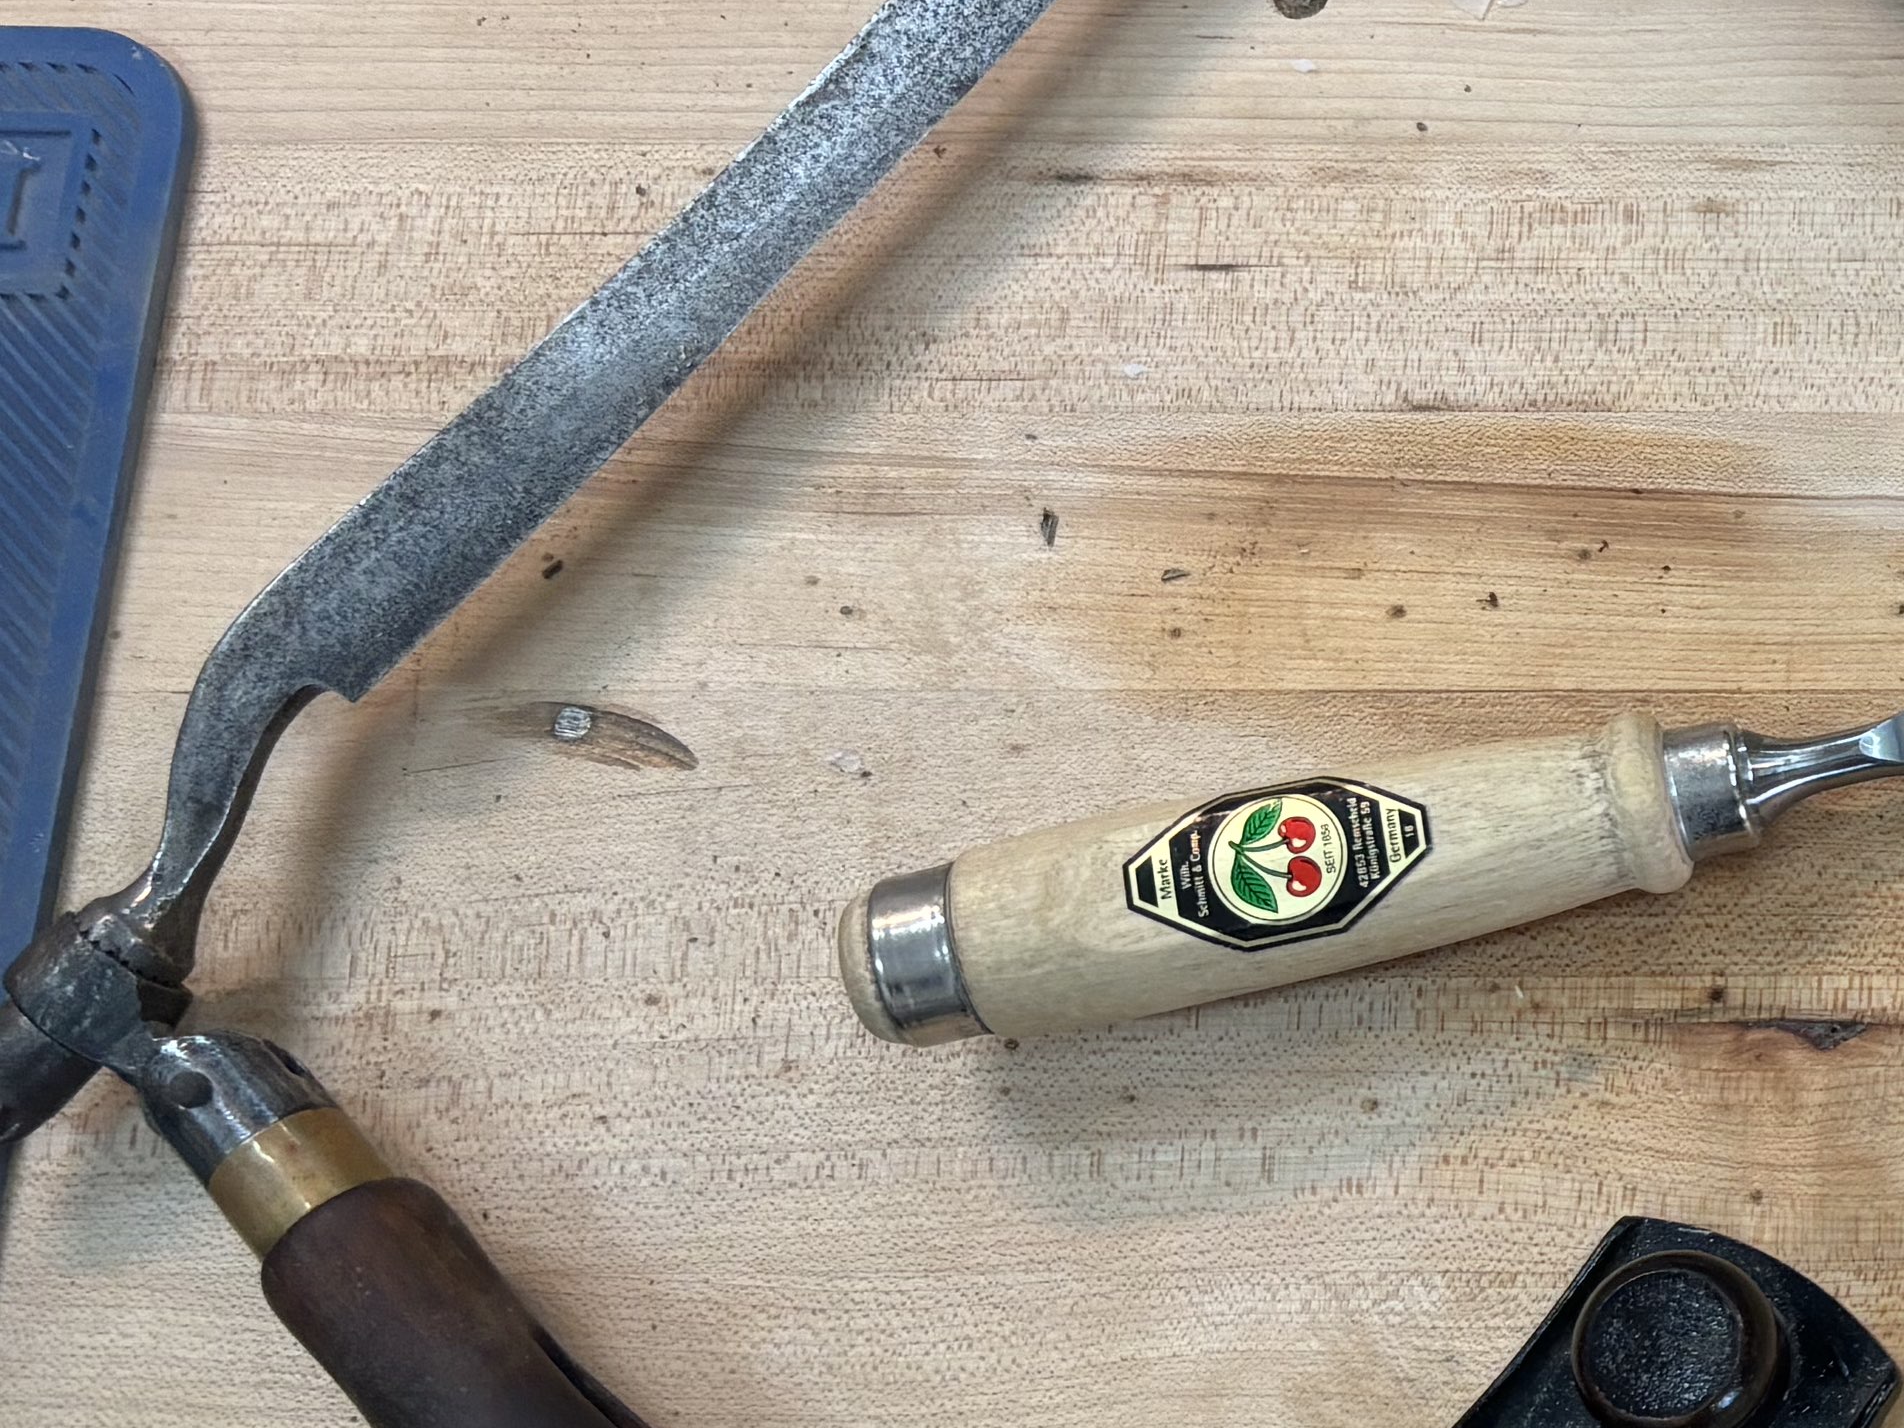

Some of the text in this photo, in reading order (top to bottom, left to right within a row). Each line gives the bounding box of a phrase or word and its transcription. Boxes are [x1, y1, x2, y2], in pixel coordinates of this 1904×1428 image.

[1346, 797, 1363, 850] Remscheid
[1385, 807, 1402, 863] Germany
[1157, 859, 1173, 900] Marke
[1189, 830, 1209, 918] Schmitt & Comp.
[1325, 850, 1337, 874] SEIT
